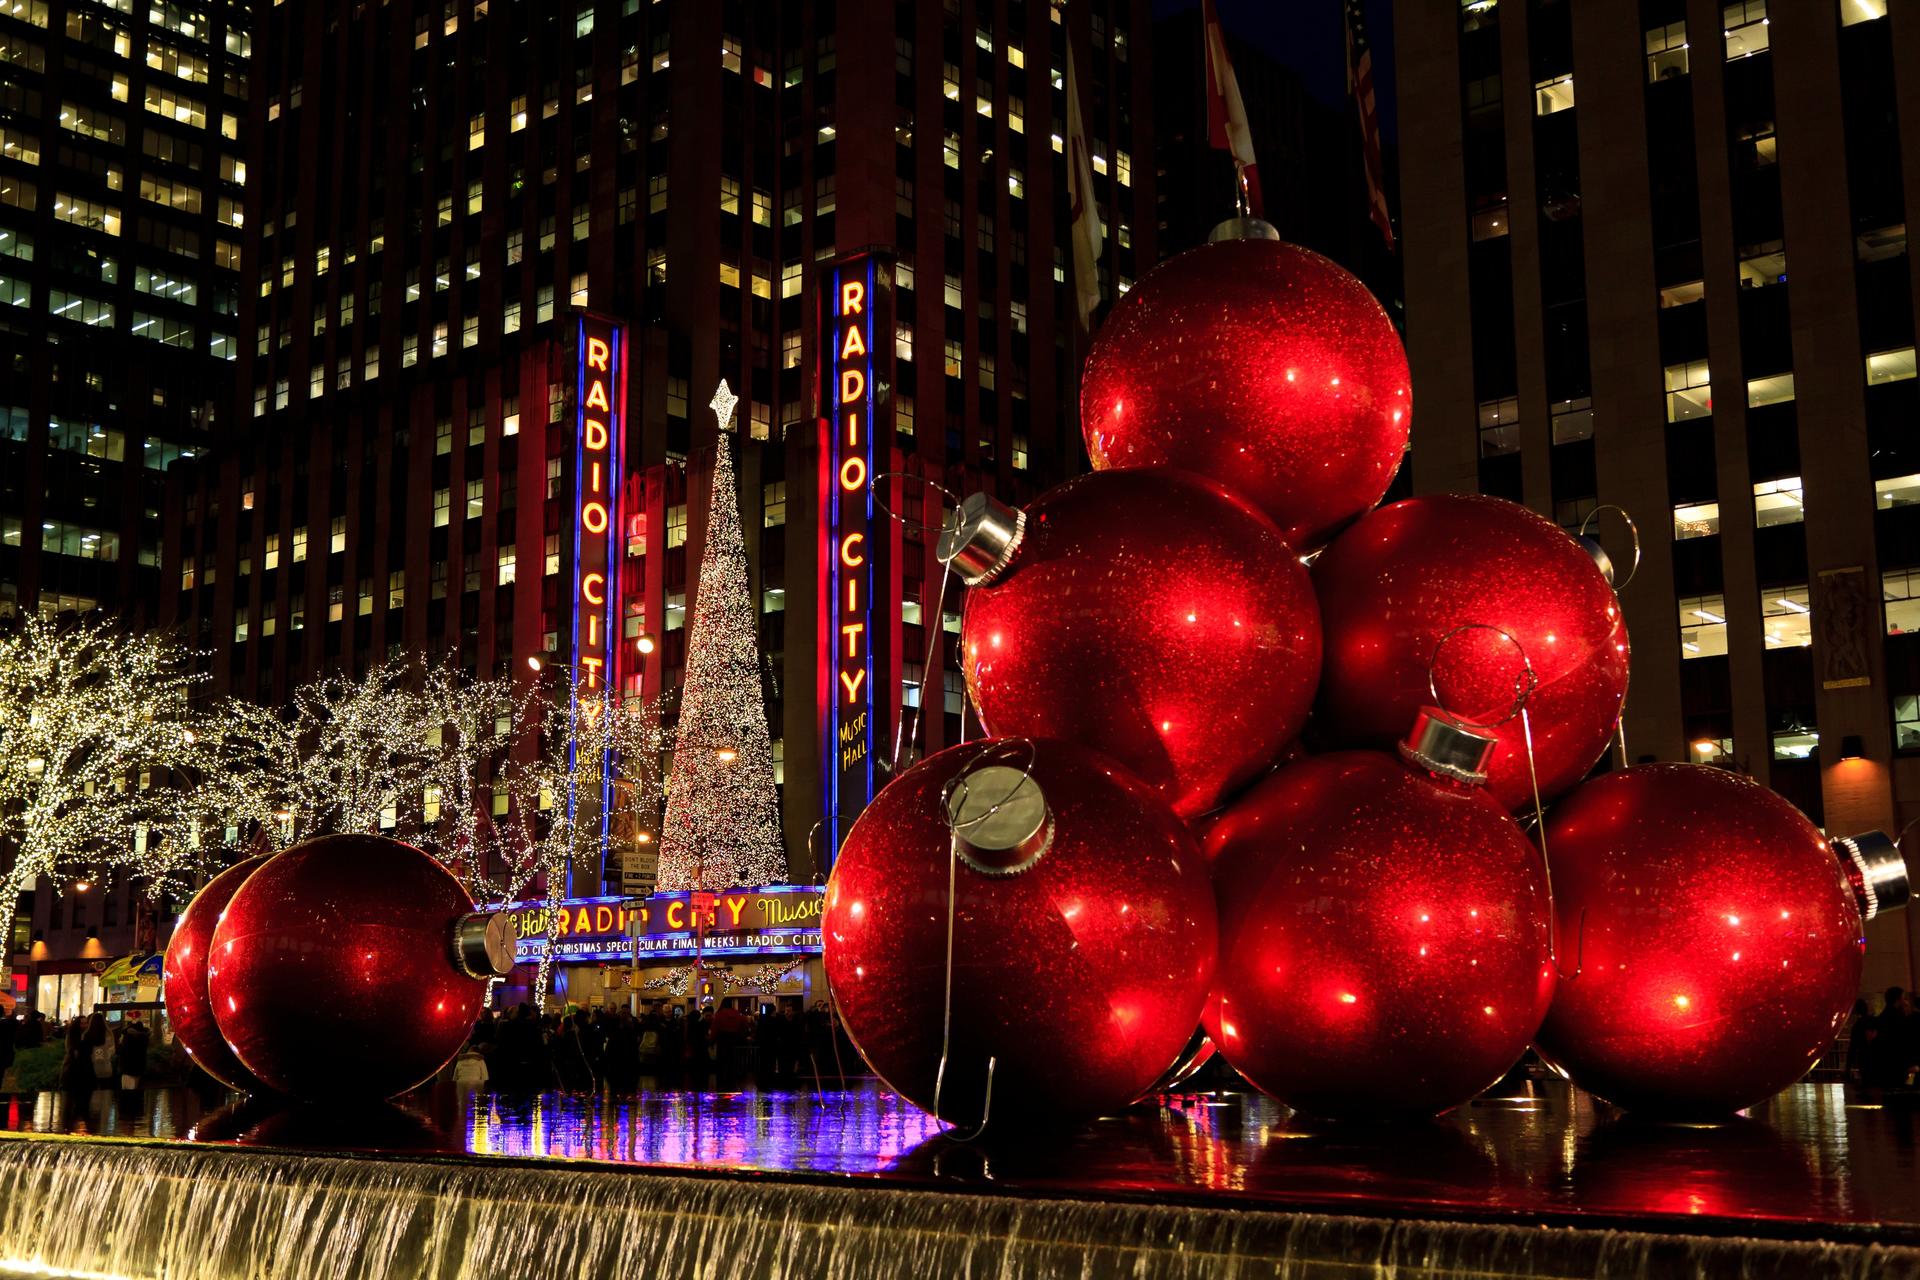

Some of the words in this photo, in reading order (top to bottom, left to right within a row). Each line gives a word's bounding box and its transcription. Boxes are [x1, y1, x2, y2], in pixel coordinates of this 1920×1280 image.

[841, 281, 867, 491] RADIO
[582, 337, 609, 534] RADIO
[580, 573, 604, 728] CITY
[840, 532, 866, 704] CITY
[840, 712, 867, 748] MUSIC
[843, 739, 868, 772] HALL
[555, 943, 601, 954] CHRISTMAS
[606, 939, 668, 952] SPECTCULAR
[672, 937, 698, 950] FINAL
[704, 936, 739, 949] WEEKS!
[746, 935, 784, 947] RADIO
[792, 934, 822, 946] CITY
[757, 898, 824, 926] Music
